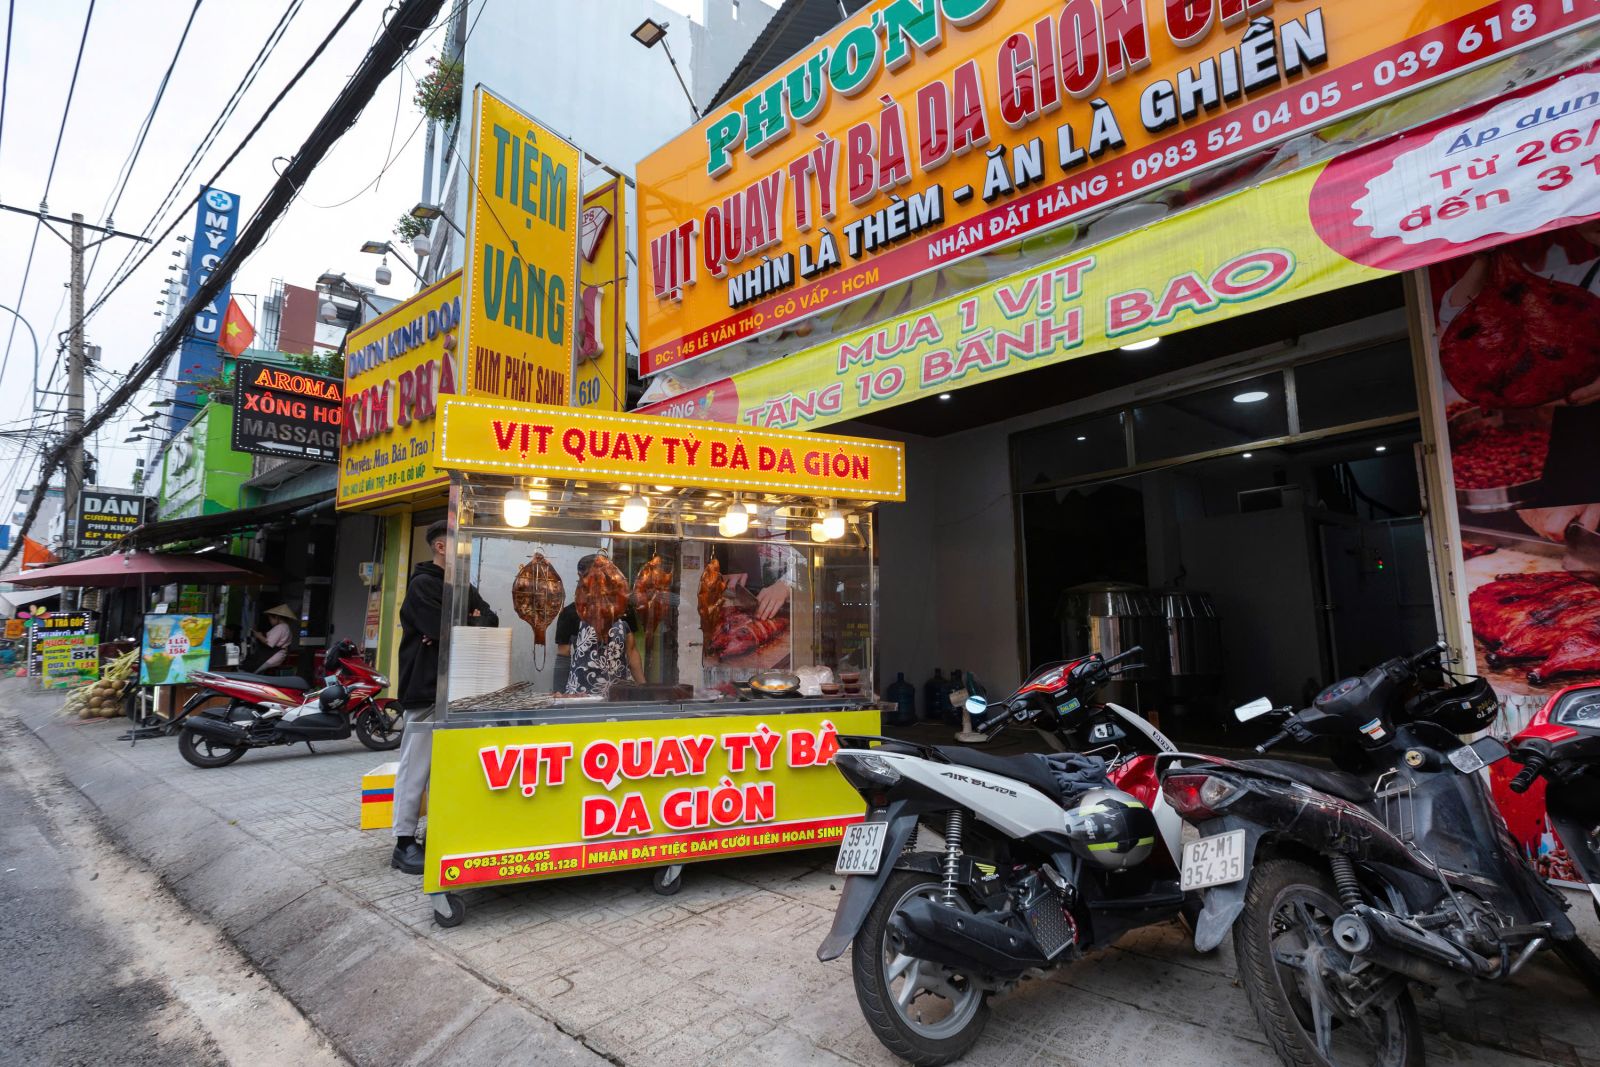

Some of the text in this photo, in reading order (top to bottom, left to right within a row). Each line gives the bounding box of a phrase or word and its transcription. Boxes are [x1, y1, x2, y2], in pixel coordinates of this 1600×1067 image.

[705, 0, 995, 177] PHƯƠN
[728, 252, 794, 307] NHÌN
[799, 227, 841, 278] LÀ
[843, 184, 943, 259] THÈM
[983, 137, 1045, 202] ĂN
[1057, 97, 1125, 171] LÀ
[1140, 7, 1328, 133] GHIỀN
[928, 223, 983, 260] NHẬN
[989, 204, 1031, 236] ĐẶT
[1037, 175, 1108, 218] HÀNG
[1131, 139, 1198, 180] 0983
[1207, 121, 1242, 151] 52
[1252, 101, 1292, 133] 04
[1299, 81, 1342, 116] 05
[1373, 40, 1444, 86] 039
[1457, 4, 1537, 53] 618
[1447, 128, 1500, 155] Áp
[493, 123, 568, 232] TIỆM
[650, 218, 698, 301] VỊT
[703, 168, 785, 277] QUAY
[788, 131, 838, 231] TỲ
[847, 94, 911, 204] BÀ
[916, 60, 989, 171] DA
[1429, 154, 1500, 190] Từ
[1399, 187, 1511, 232] đến
[483, 240, 565, 346] VÀNG
[655, 351, 674, 365] ĐC:
[676, 341, 695, 357] 145
[698, 332, 709, 350] LÊ
[711, 324, 736, 344] VĂN
[739, 313, 764, 332] THỌ
[774, 297, 796, 318] GÒ
[800, 283, 829, 315] VẤP
[841, 267, 879, 294] HCM
[836, 255, 1096, 374] MUA 1 VỊT
[348, 337, 386, 379] DNTN
[387, 315, 426, 360] KINH
[856, 364, 905, 407] 10
[1105, 247, 1297, 338] BAO
[254, 368, 341, 401] AROMA
[474, 345, 564, 406] KIM PHÁT SANH
[578, 376, 601, 407] 610
[243, 391, 342, 425] XÔNG HƠ
[342, 379, 395, 446] KIM
[373, 449, 389, 469] Mua
[391, 443, 407, 463] Bán
[410, 437, 428, 458] Trao
[492, 420, 870, 480] VỊT QUAY TỲ BÀ DA GIÒN
[84, 496, 139, 516] DÁN
[73, 650, 97, 660] 8K
[479, 719, 841, 798] VỊT QUAY TỲ BÀ
[940, 771, 1018, 798] AIR BLADE
[581, 775, 777, 839] DA GIÒN
[463, 850, 551, 869] 0983.520.405
[498, 858, 579, 877] 0396.181.128
[588, 848, 629, 864] NHẬN
[631, 845, 658, 860] ĐẶT
[660, 841, 688, 856] TIỆC
[753, 832, 779, 846] LIÊN
[782, 829, 815, 842] HOAN
[817, 826, 843, 839] SINH
[838, 849, 878, 870] 688.42
[1184, 856, 1240, 887] 354.35
